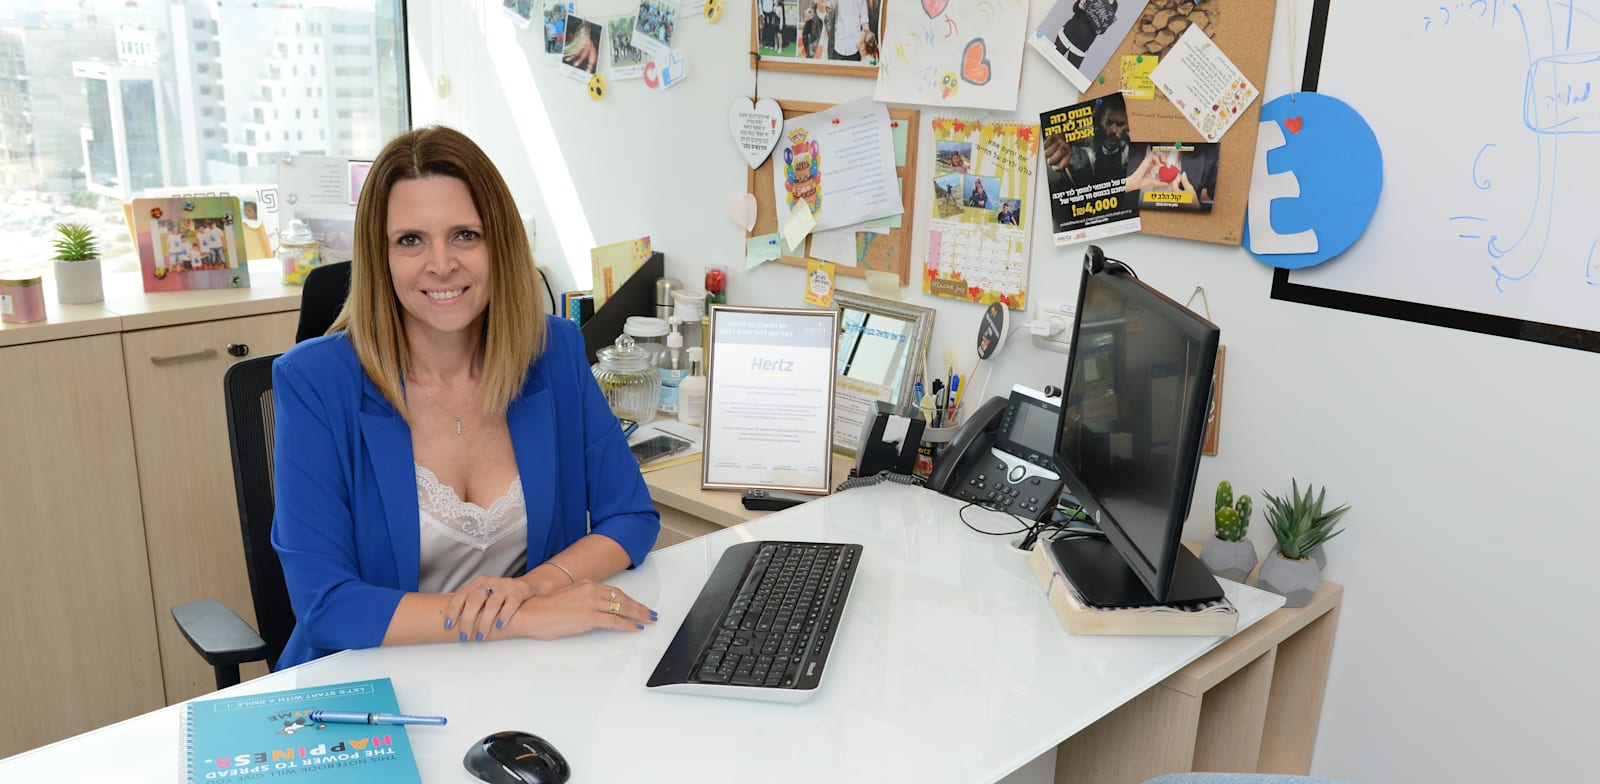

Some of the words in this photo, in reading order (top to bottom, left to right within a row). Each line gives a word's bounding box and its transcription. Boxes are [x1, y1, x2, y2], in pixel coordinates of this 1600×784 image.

[1050, 113, 1067, 125] כזה
[1068, 106, 1092, 120] בונוס
[1062, 120, 1076, 132] לא
[1077, 117, 1093, 129] עוד
[1045, 125, 1061, 137] היה
[1065, 128, 1095, 143] אצלנו!
[1248, 120, 1319, 254] E
[751, 357, 795, 373] Hertz
[204, 735, 392, 769] HAPPINESS.
[364, 748, 395, 757] THE
[303, 752, 360, 766] POWER
[371, 755, 397, 765] THIS
[205, 764, 269, 779] SPREAD
[275, 761, 298, 770] TO
[300, 759, 367, 773] NOTEBOOK
[238, 772, 264, 782] GIVE
[270, 768, 297, 777] WILL
